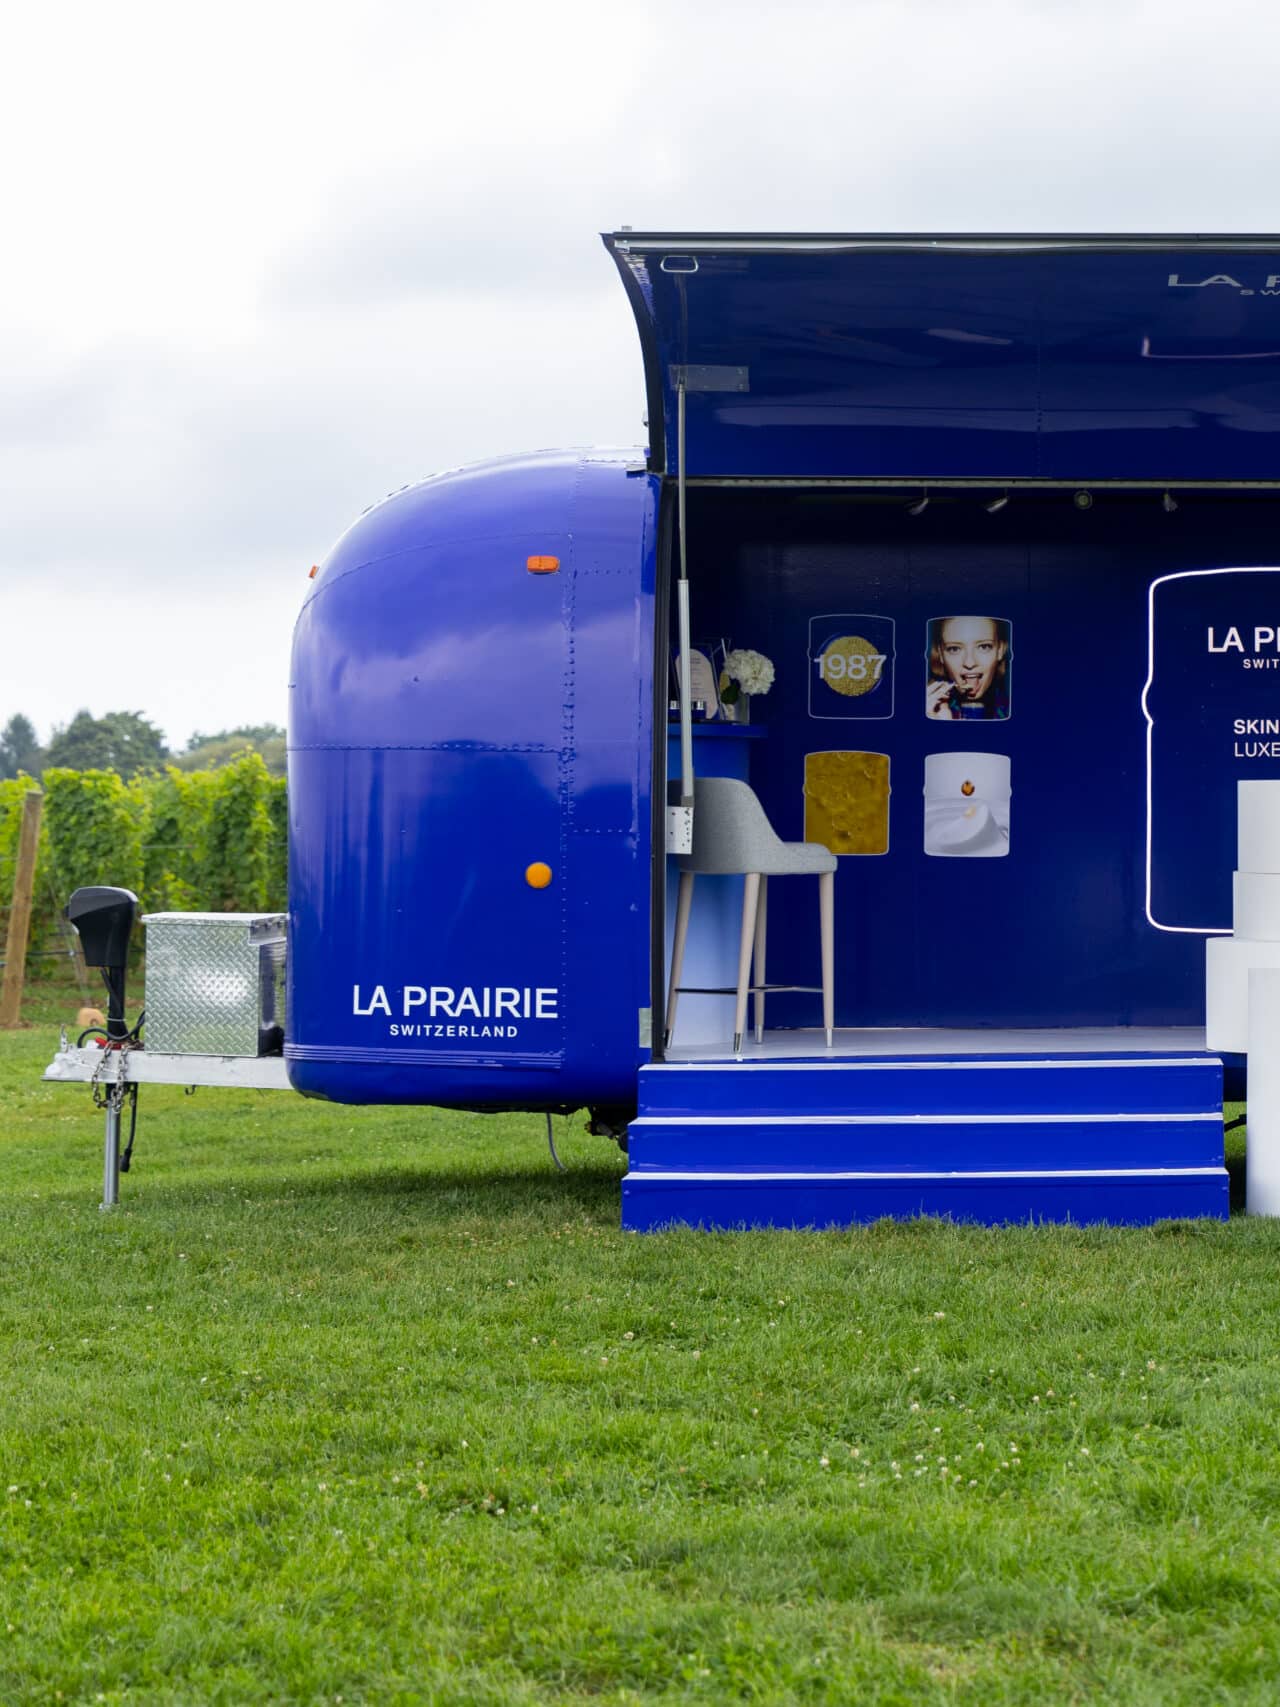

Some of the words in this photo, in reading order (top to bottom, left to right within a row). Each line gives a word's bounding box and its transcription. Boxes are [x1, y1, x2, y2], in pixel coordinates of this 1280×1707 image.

[1167, 274, 1242, 288] LA
[1207, 626, 1245, 653] LA
[813, 653, 887, 680] 1987
[1233, 719, 1280, 735] SKIN
[353, 984, 393, 1016] LA
[403, 985, 558, 1019] PRAIRIE
[389, 1023, 518, 1038] SWITZERLAND
